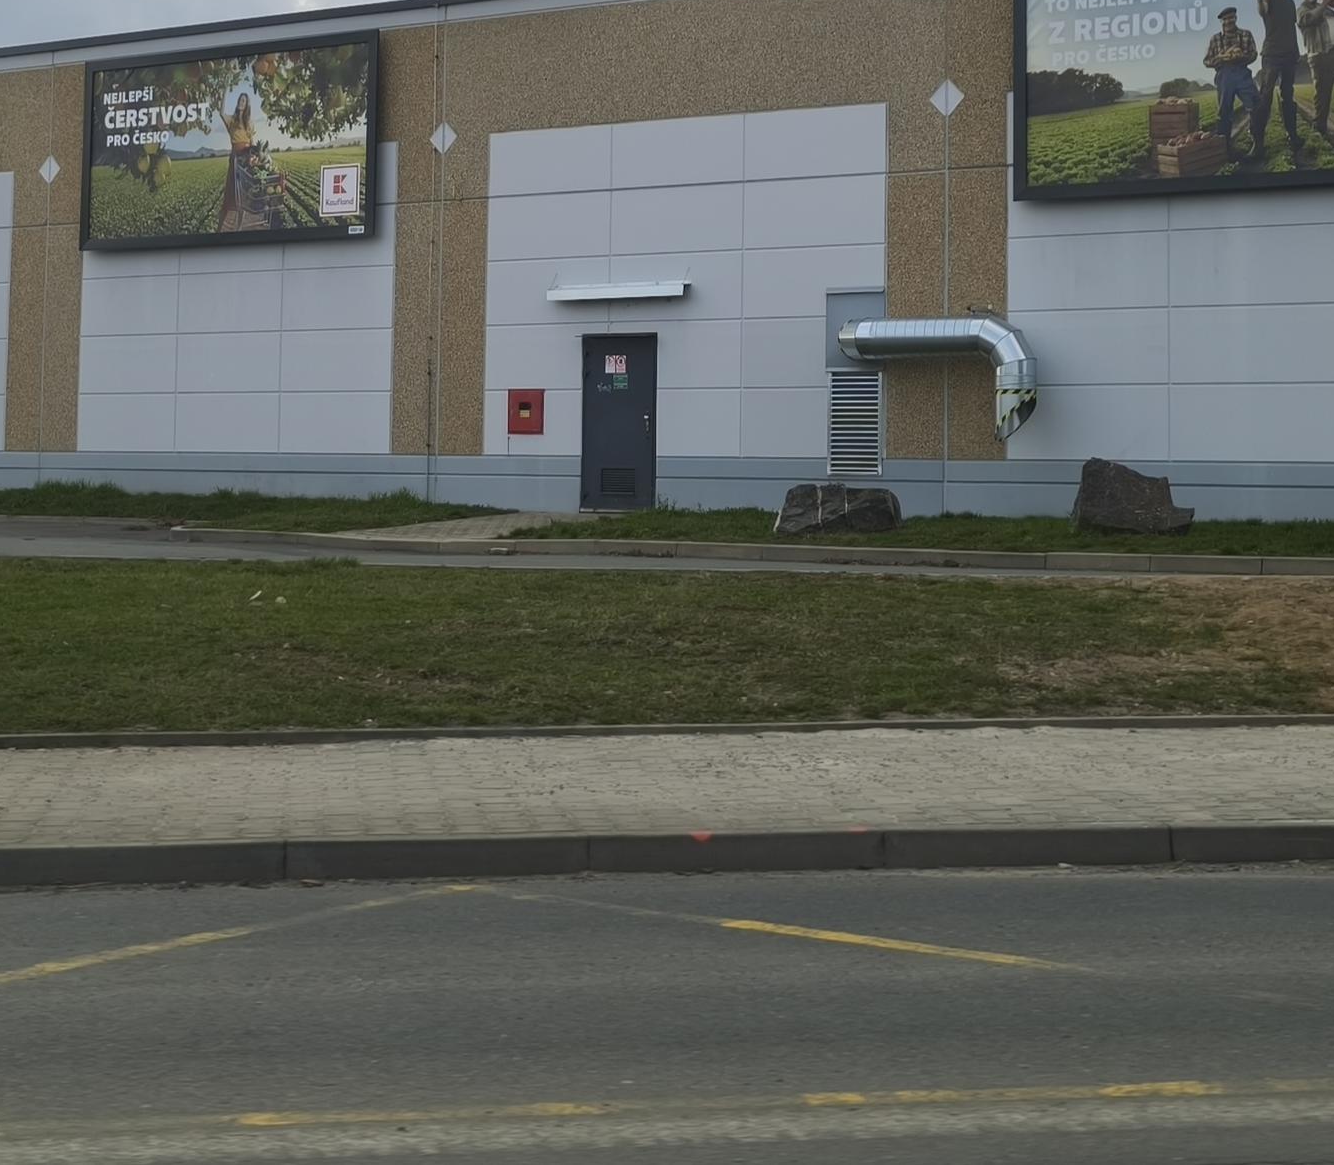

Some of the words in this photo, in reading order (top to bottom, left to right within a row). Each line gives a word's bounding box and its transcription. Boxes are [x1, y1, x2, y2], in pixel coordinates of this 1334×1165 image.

[1048, 21, 1066, 45] Z
[1074, 0, 1208, 43] REGIONŮ
[1051, 50, 1089, 67] PRO
[1095, 44, 1156, 63] ČESKO
[103, 86, 154, 105] NEJLEPŠÍ
[104, 102, 210, 130] ČERSTVOST
[106, 134, 130, 148] PRO
[132, 130, 170, 145] ČESKO
